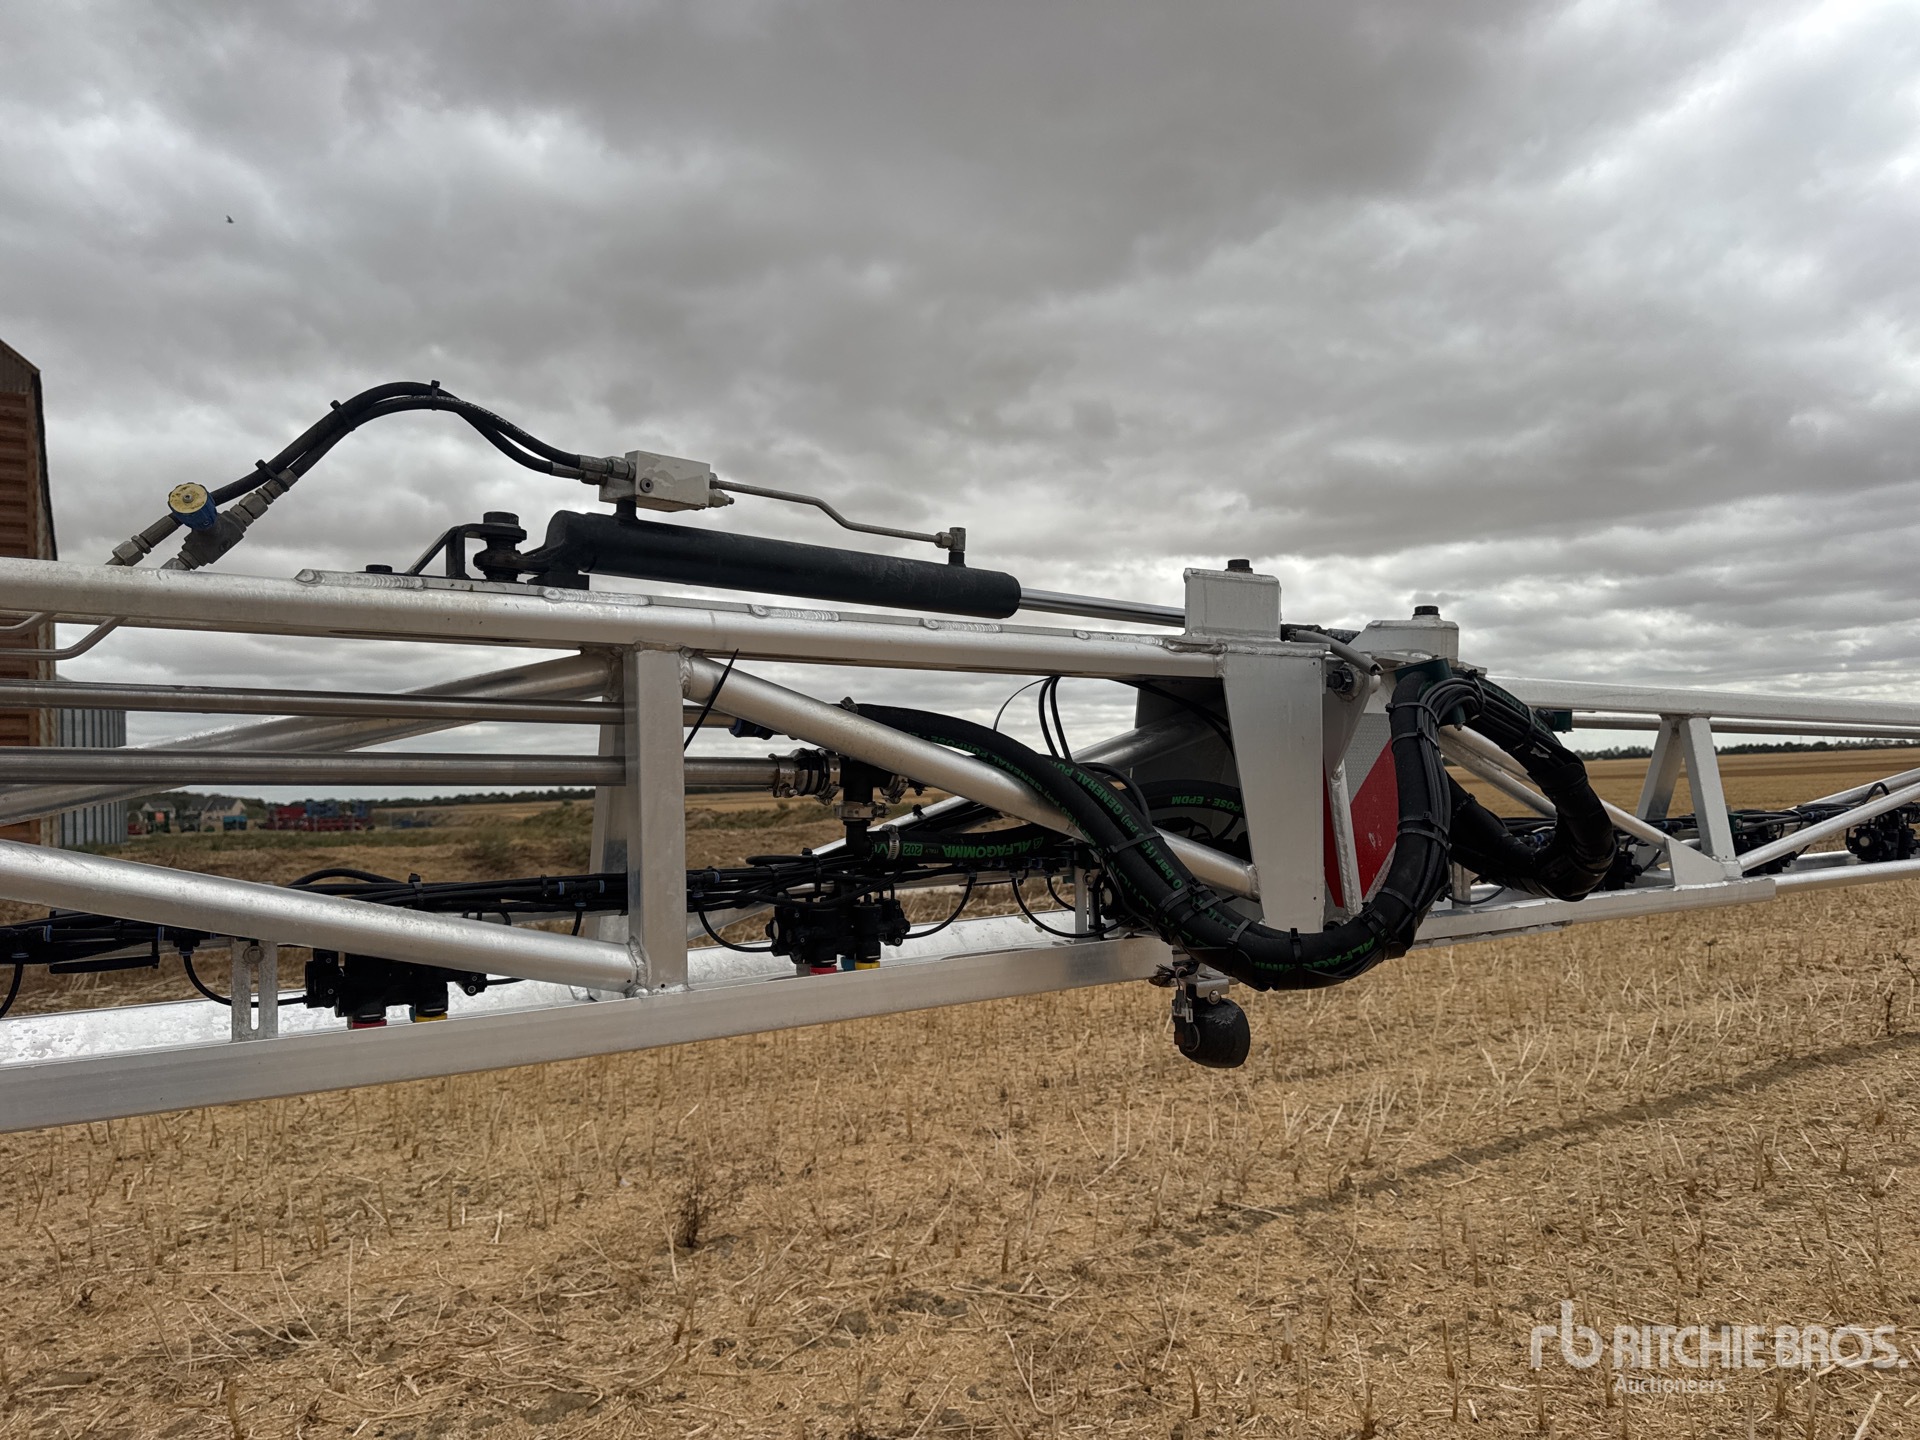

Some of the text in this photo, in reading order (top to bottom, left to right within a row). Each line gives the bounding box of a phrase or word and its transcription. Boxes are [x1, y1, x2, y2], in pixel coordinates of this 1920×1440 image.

[930, 735, 989, 758] PURPOSE
[992, 754, 1044, 792] GENERAL
[1075, 771, 1124, 815] GENERAL
[1171, 795, 1243, 813] POSE EPDM
[1120, 814, 1139, 834] psi)
[941, 839, 1032, 858] ALFAGOMMA
[1155, 857, 1175, 878] bar
